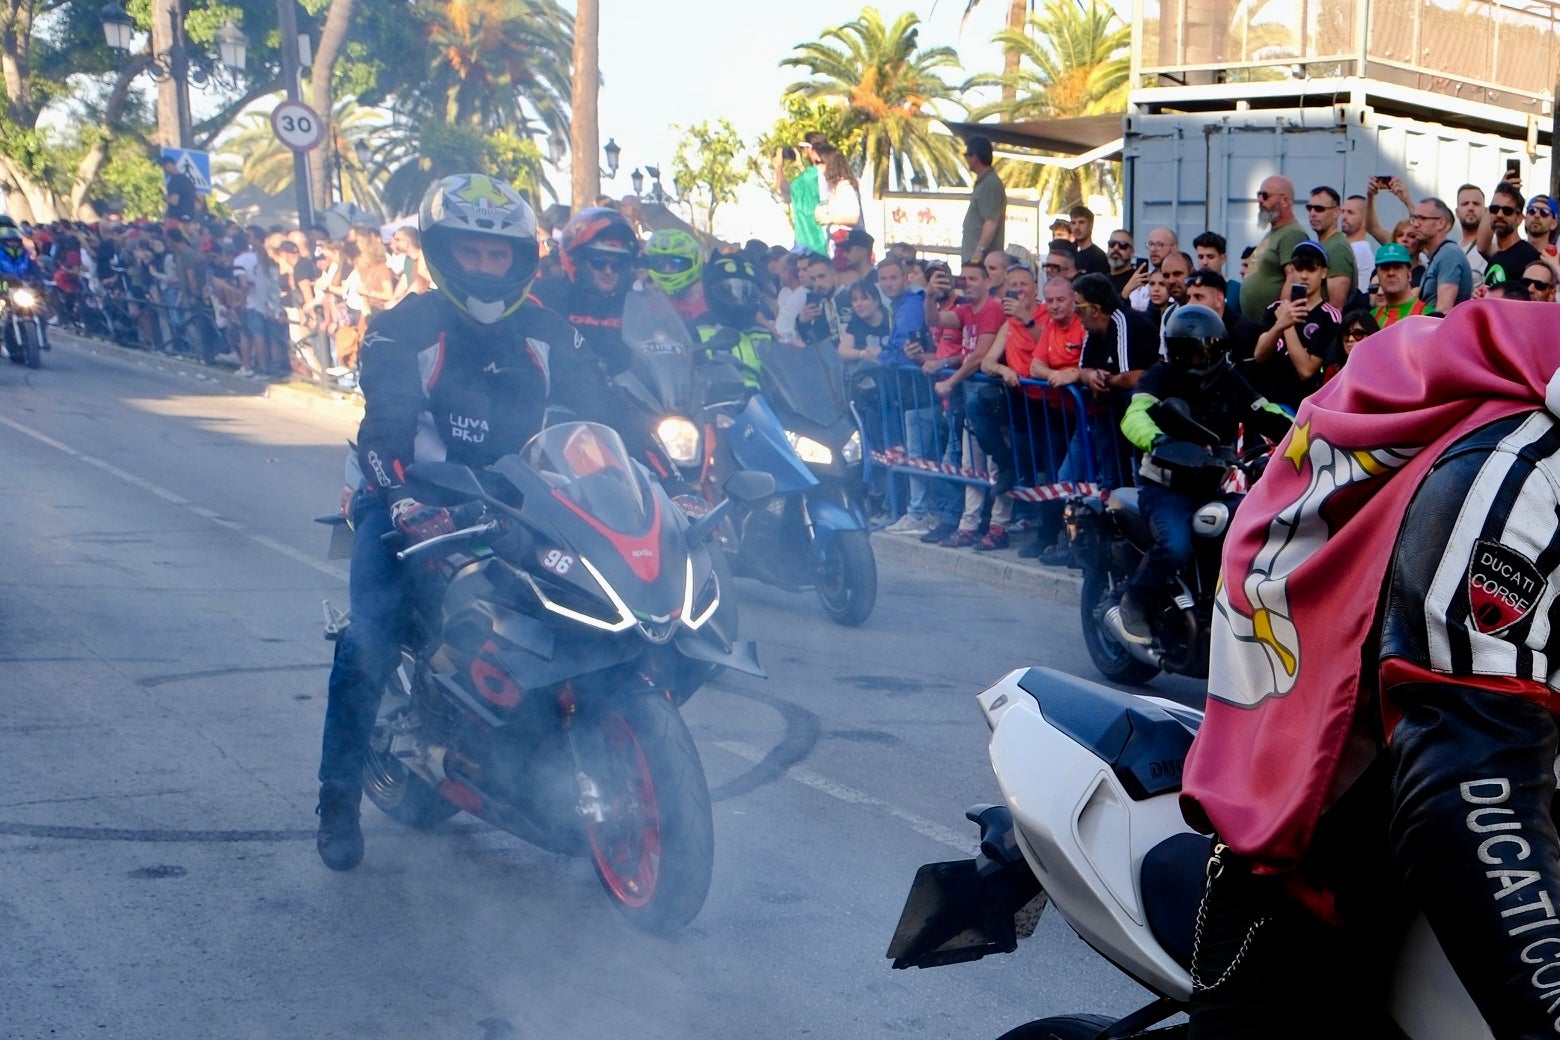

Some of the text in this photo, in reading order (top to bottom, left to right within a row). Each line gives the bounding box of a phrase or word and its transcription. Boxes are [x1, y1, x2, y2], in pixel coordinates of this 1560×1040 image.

[282, 115, 311, 132] 30
[450, 413, 489, 431] LUVA
[543, 549, 573, 574] 96
[1480, 552, 1535, 593] DUCATI
[1471, 573, 1530, 615] CORSE
